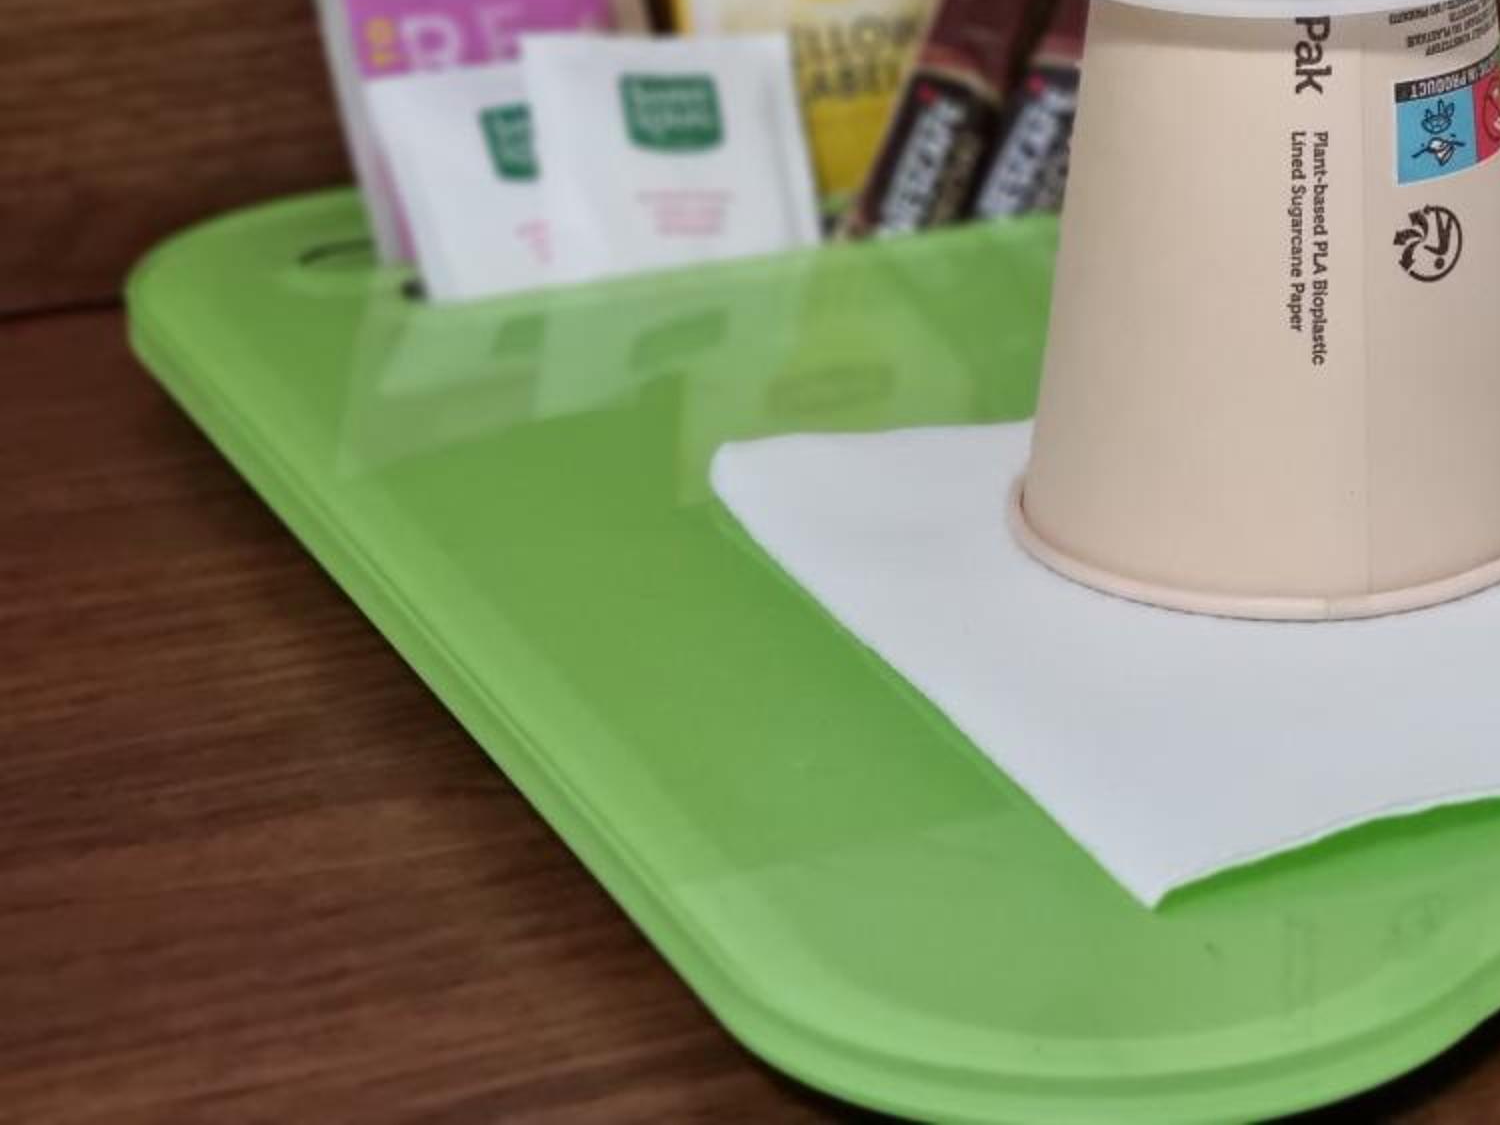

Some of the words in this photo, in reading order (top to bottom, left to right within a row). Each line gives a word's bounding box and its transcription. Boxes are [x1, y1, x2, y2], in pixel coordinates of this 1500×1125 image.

[1294, 15, 1332, 94] Pak
[1410, 71, 1466, 97] PRODUCT
[1291, 130, 1307, 180] Lined
[1312, 130, 1329, 236] Plant-based
[1287, 184, 1307, 278] Sugarcane
[1312, 240, 1328, 274] PLA
[1286, 282, 1305, 333] Paper
[1310, 280, 1329, 366] Bioplastic
